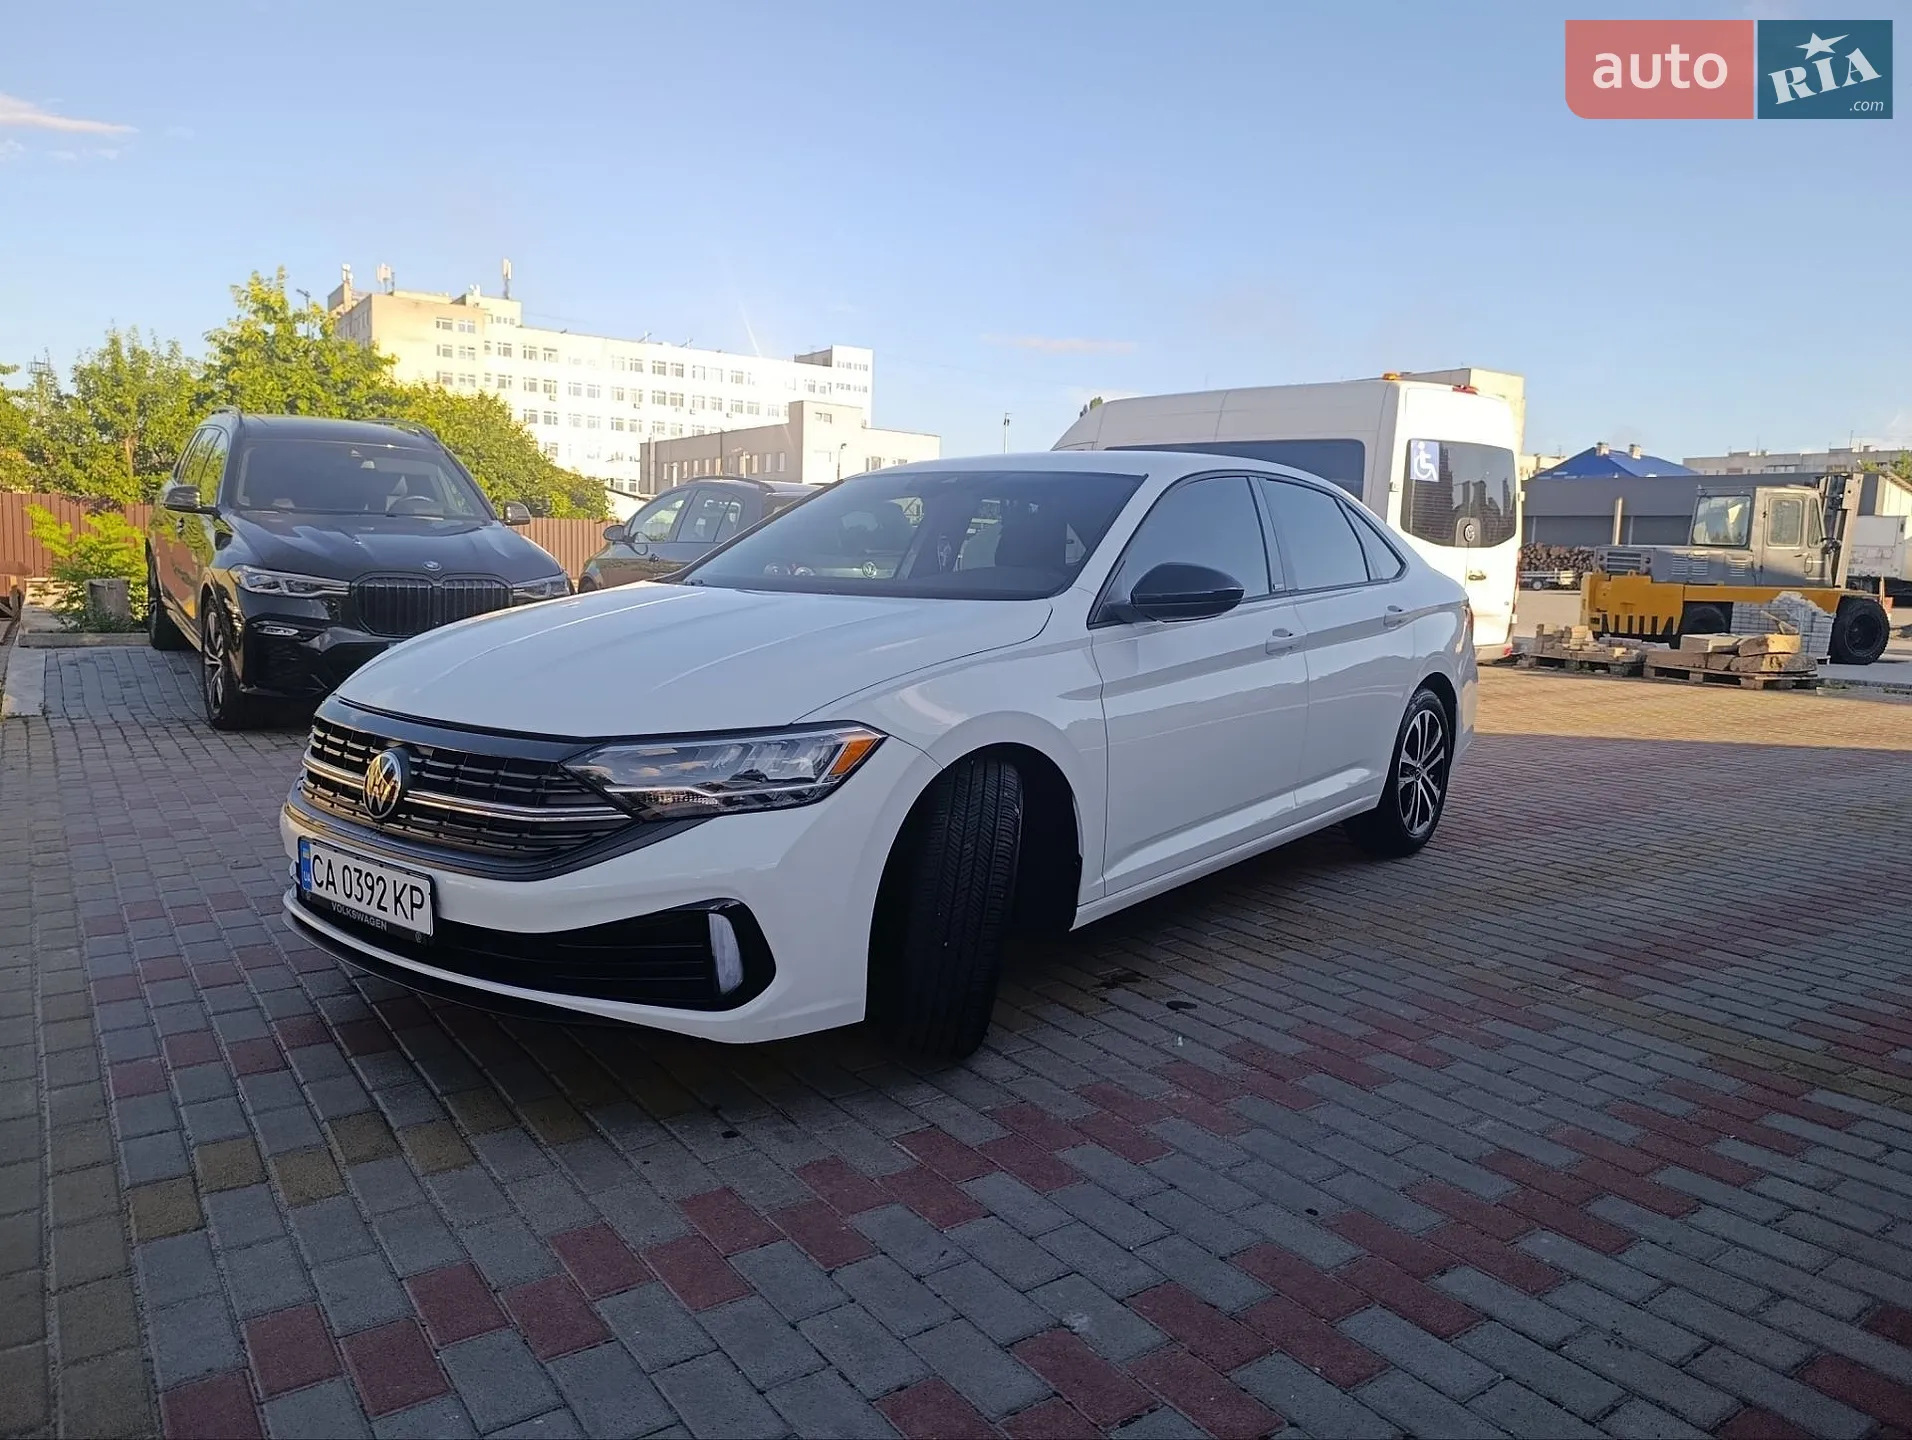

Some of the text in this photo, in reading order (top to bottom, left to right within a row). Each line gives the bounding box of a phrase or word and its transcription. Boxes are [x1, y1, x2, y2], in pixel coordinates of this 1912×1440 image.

[312, 854, 425, 921] CA 0392 KP
[331, 901, 388, 932] VOLKSWAGEN
